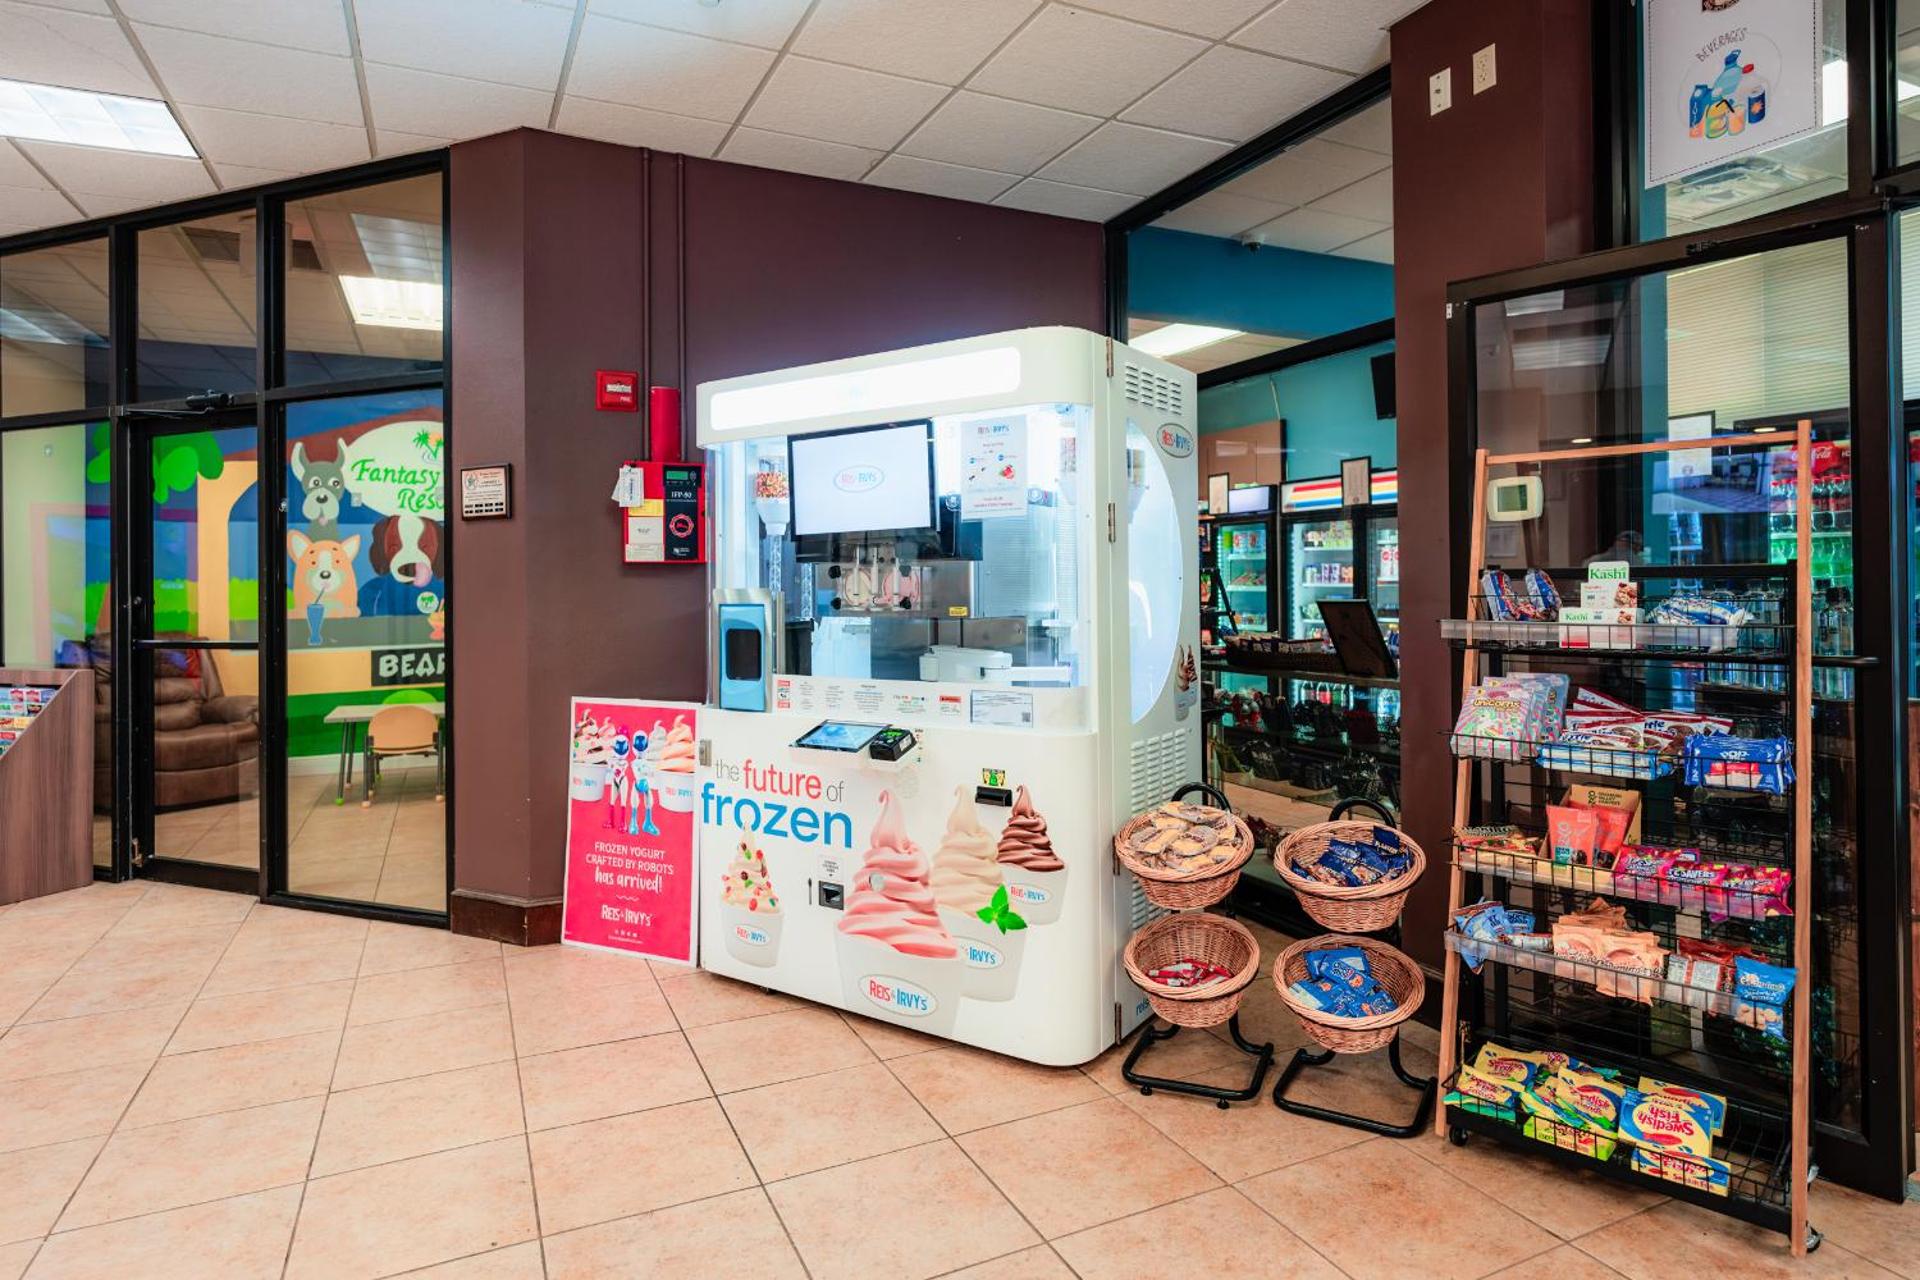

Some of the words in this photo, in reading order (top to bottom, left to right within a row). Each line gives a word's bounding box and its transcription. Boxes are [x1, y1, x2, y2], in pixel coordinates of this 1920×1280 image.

[1695, 27, 1748, 62] BEVERAGES
[351, 458, 441, 492] Fantasy
[1590, 567, 1627, 580] Kashi
[715, 759, 740, 782] the
[743, 759, 822, 800] future
[826, 780, 844, 803] of
[701, 782, 852, 848] frozen
[594, 841, 628, 856] FROZEN
[629, 846, 666, 860] YOGURT
[586, 853, 623, 868] CRAFTED
[625, 858, 636, 870] BY
[637, 860, 674, 875] ROBOTS
[594, 865, 614, 885] has
[616, 873, 663, 894] arrived!
[601, 904, 620, 921] REIS
[869, 980, 892, 1002] REIS
[1637, 1111, 1694, 1136] Swedish
[1649, 1105, 1681, 1123] Fish
